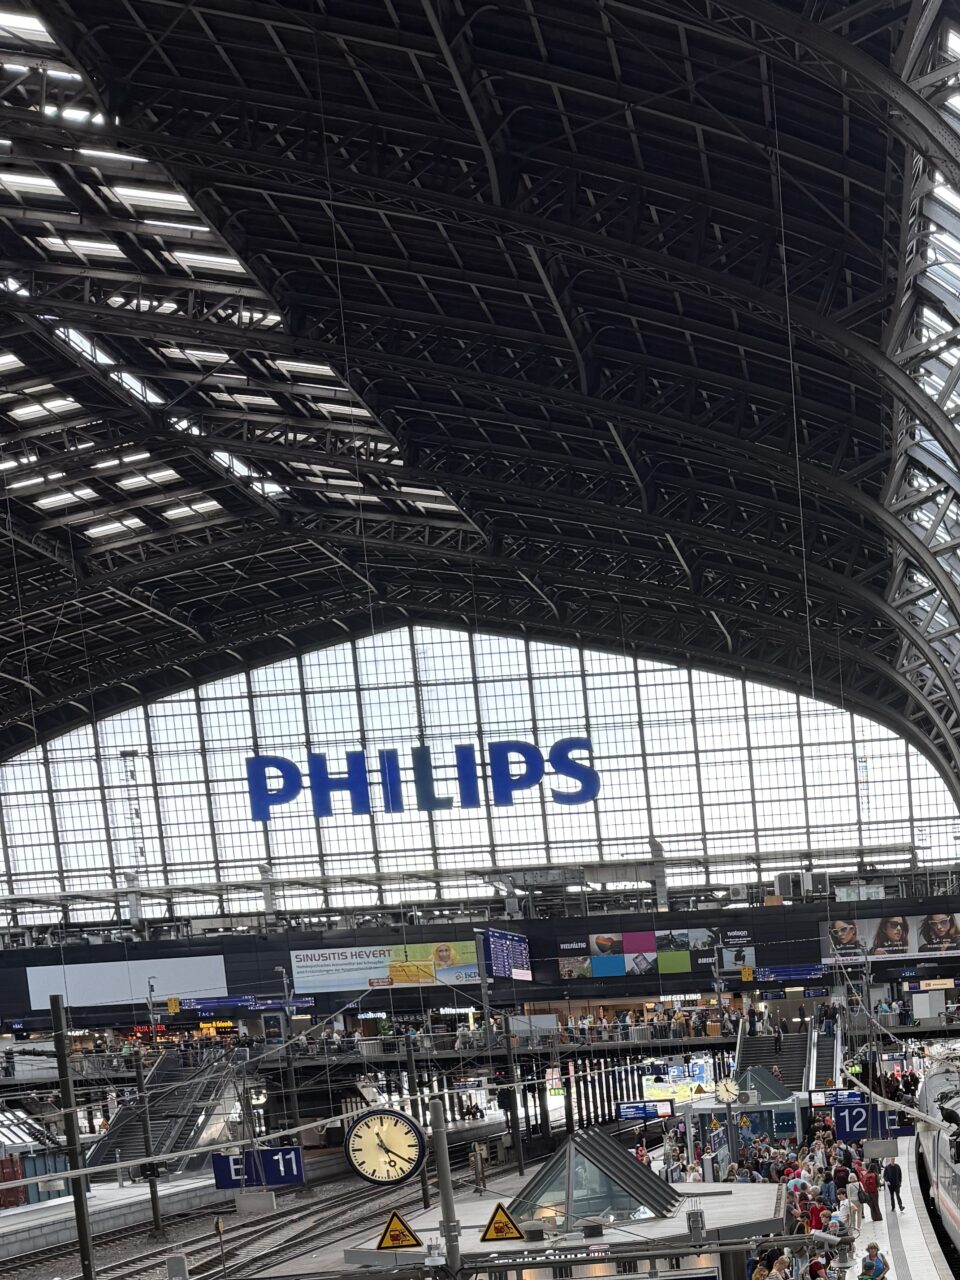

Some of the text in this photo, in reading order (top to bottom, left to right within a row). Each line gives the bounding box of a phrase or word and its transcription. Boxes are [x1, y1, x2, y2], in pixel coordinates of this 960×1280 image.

[245, 737, 600, 822] PHILIPS
[295, 949, 393, 963] SINUSITIS HEVERT
[660, 993, 702, 1002] BURGER KING
[840, 1108, 867, 1132] 12
[229, 1151, 297, 1180] E 11
